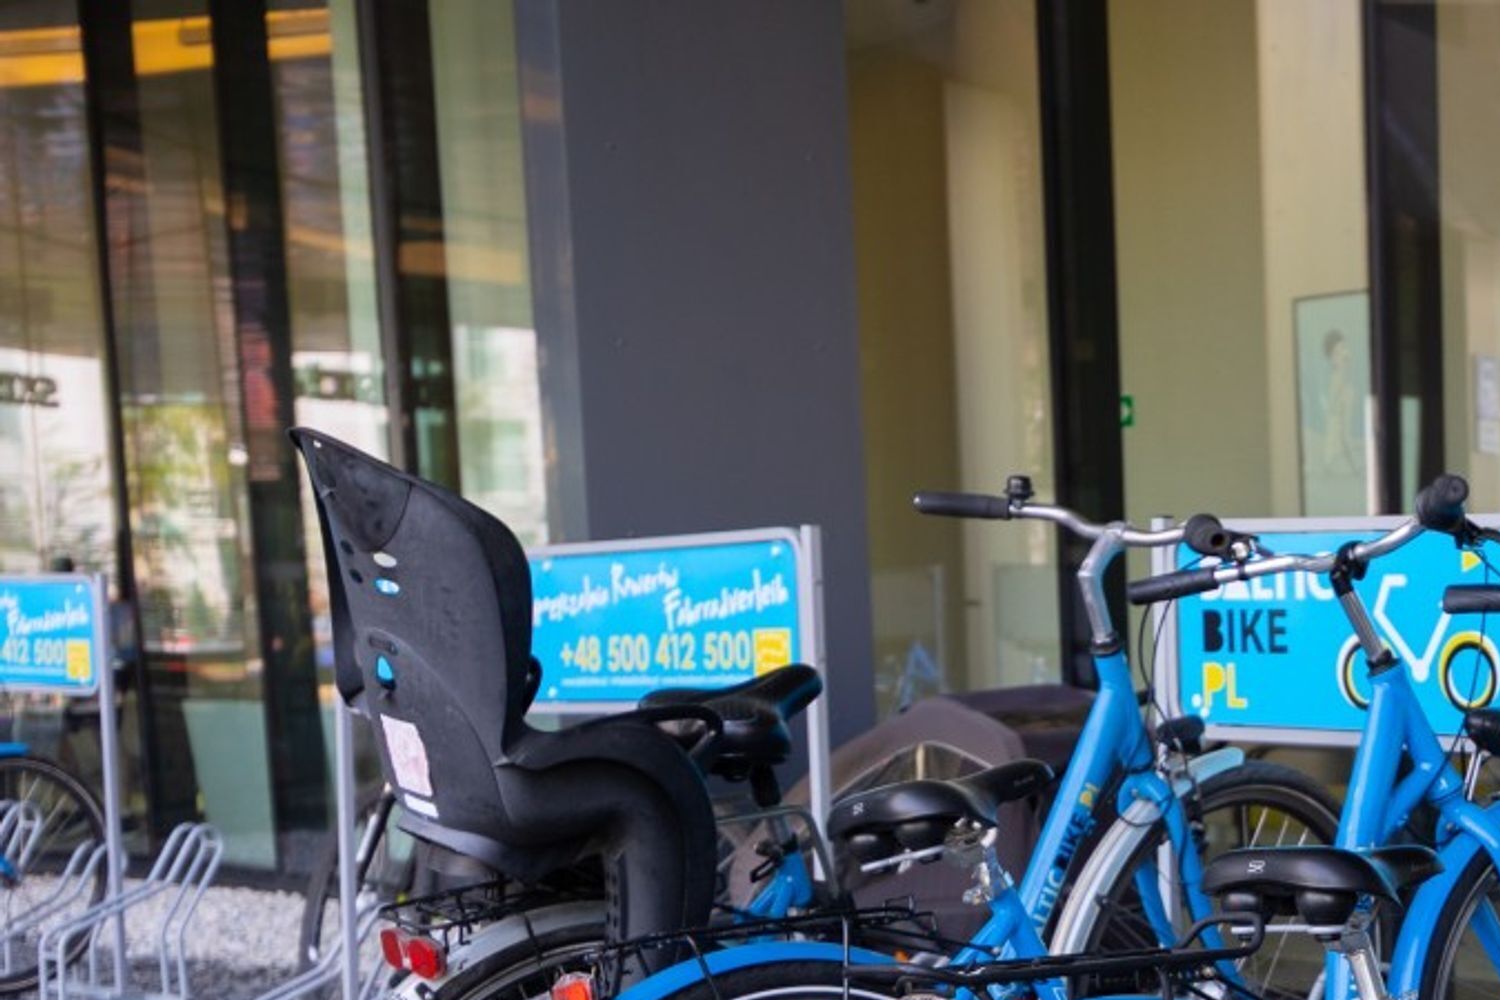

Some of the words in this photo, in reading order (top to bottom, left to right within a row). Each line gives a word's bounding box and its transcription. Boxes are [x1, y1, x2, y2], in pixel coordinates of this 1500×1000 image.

[561, 634, 601, 673] +48
[608, 634, 649, 673] 500
[655, 632, 696, 672] 412
[703, 630, 750, 671] 500
[1202, 608, 1289, 654] BIKE
